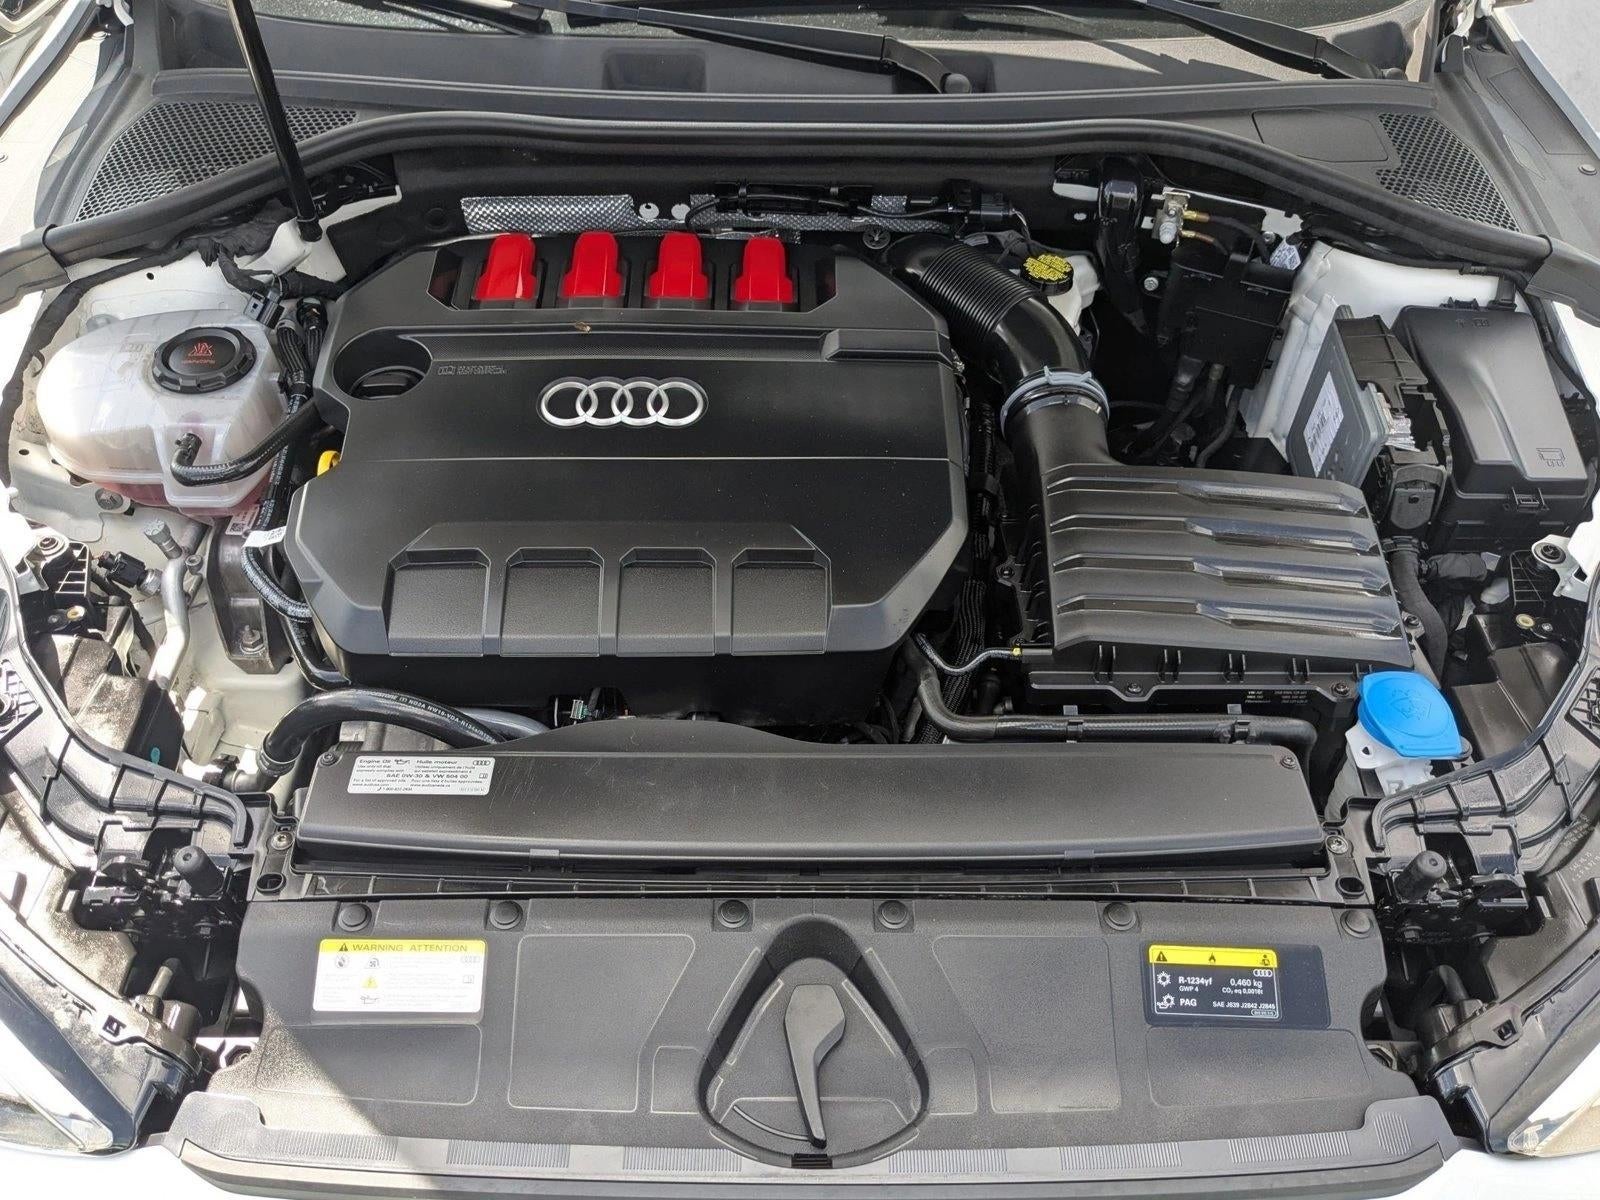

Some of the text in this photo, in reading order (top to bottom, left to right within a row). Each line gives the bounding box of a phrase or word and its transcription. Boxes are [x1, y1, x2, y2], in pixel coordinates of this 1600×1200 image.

[352, 943, 467, 952] WARNING ATTENTION
[1178, 976, 1212, 987] R-1234yf
[1230, 978, 1263, 989] 0,460 kg
[1180, 998, 1197, 1007] PAG
